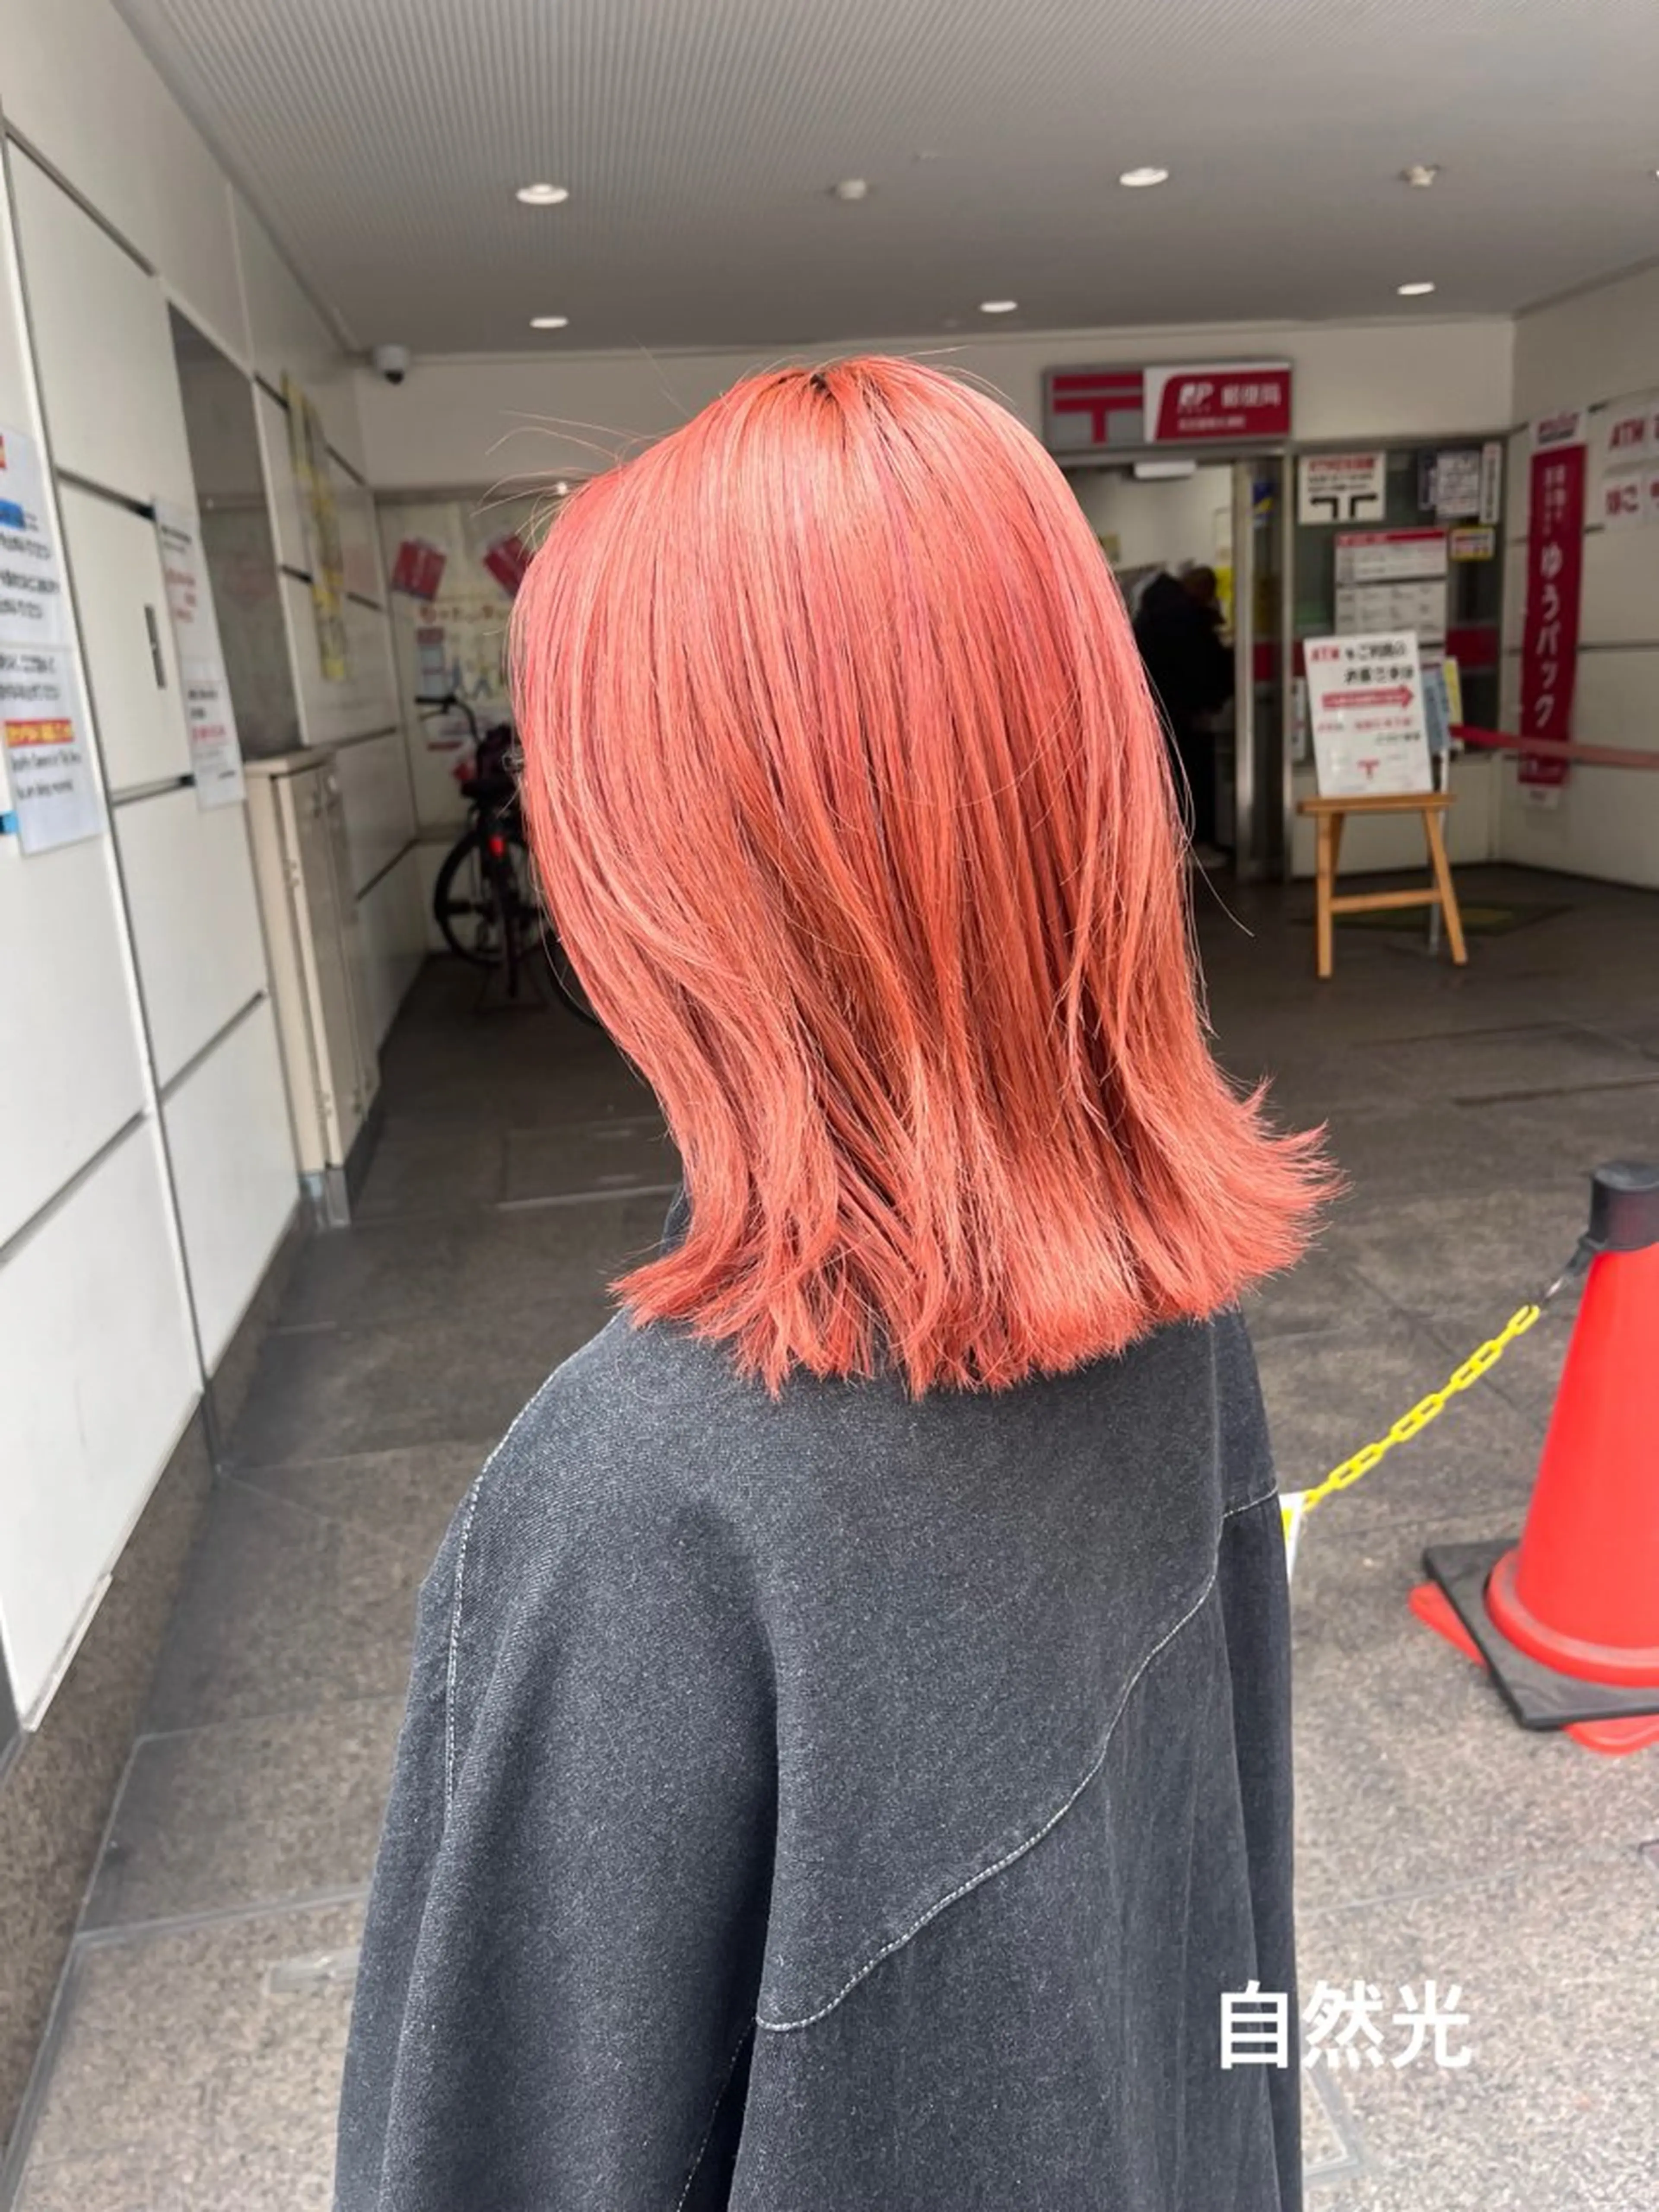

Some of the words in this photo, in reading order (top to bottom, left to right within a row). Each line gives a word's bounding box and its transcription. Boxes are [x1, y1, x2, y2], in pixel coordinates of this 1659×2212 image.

[1535, 542, 1563, 728] ゆうパック
